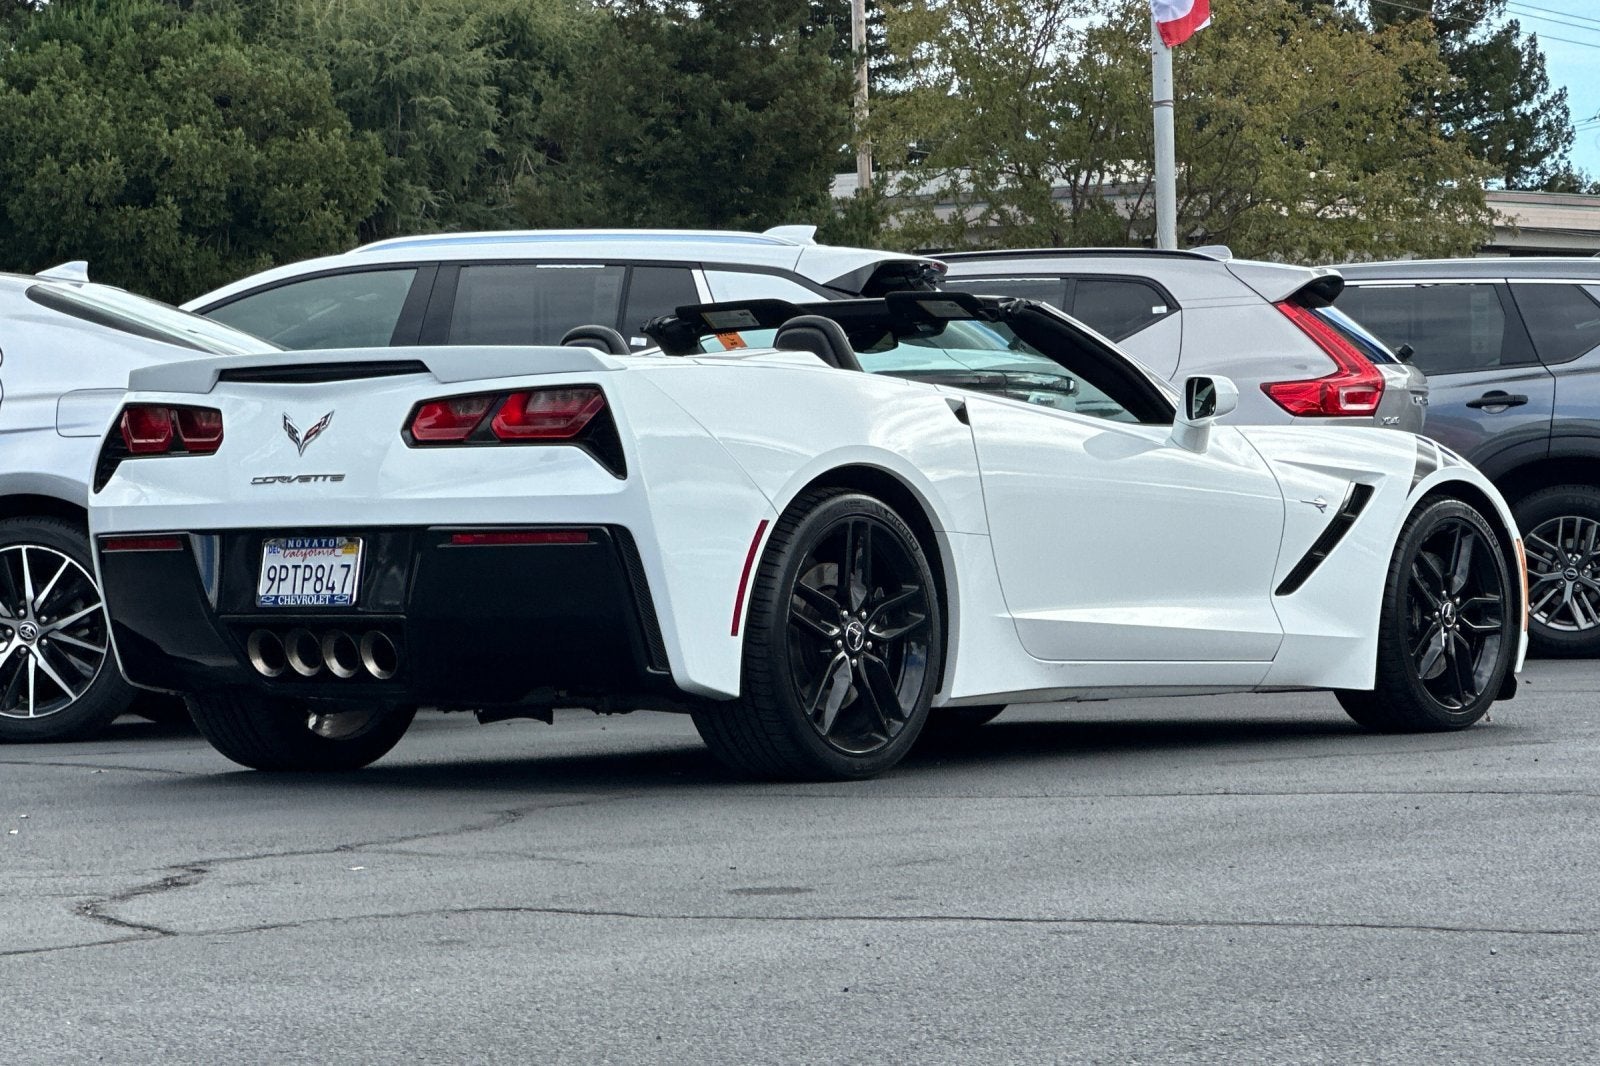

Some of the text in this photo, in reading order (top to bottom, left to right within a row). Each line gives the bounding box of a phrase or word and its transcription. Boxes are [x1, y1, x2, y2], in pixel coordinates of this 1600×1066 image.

[251, 474, 345, 485] CORVETTE
[886, 511, 919, 550] MICHELIN
[287, 539, 335, 548] NOVATO
[283, 548, 342, 562] California
[265, 564, 351, 594] 9PTP847
[278, 594, 330, 605] CHEVROLET
